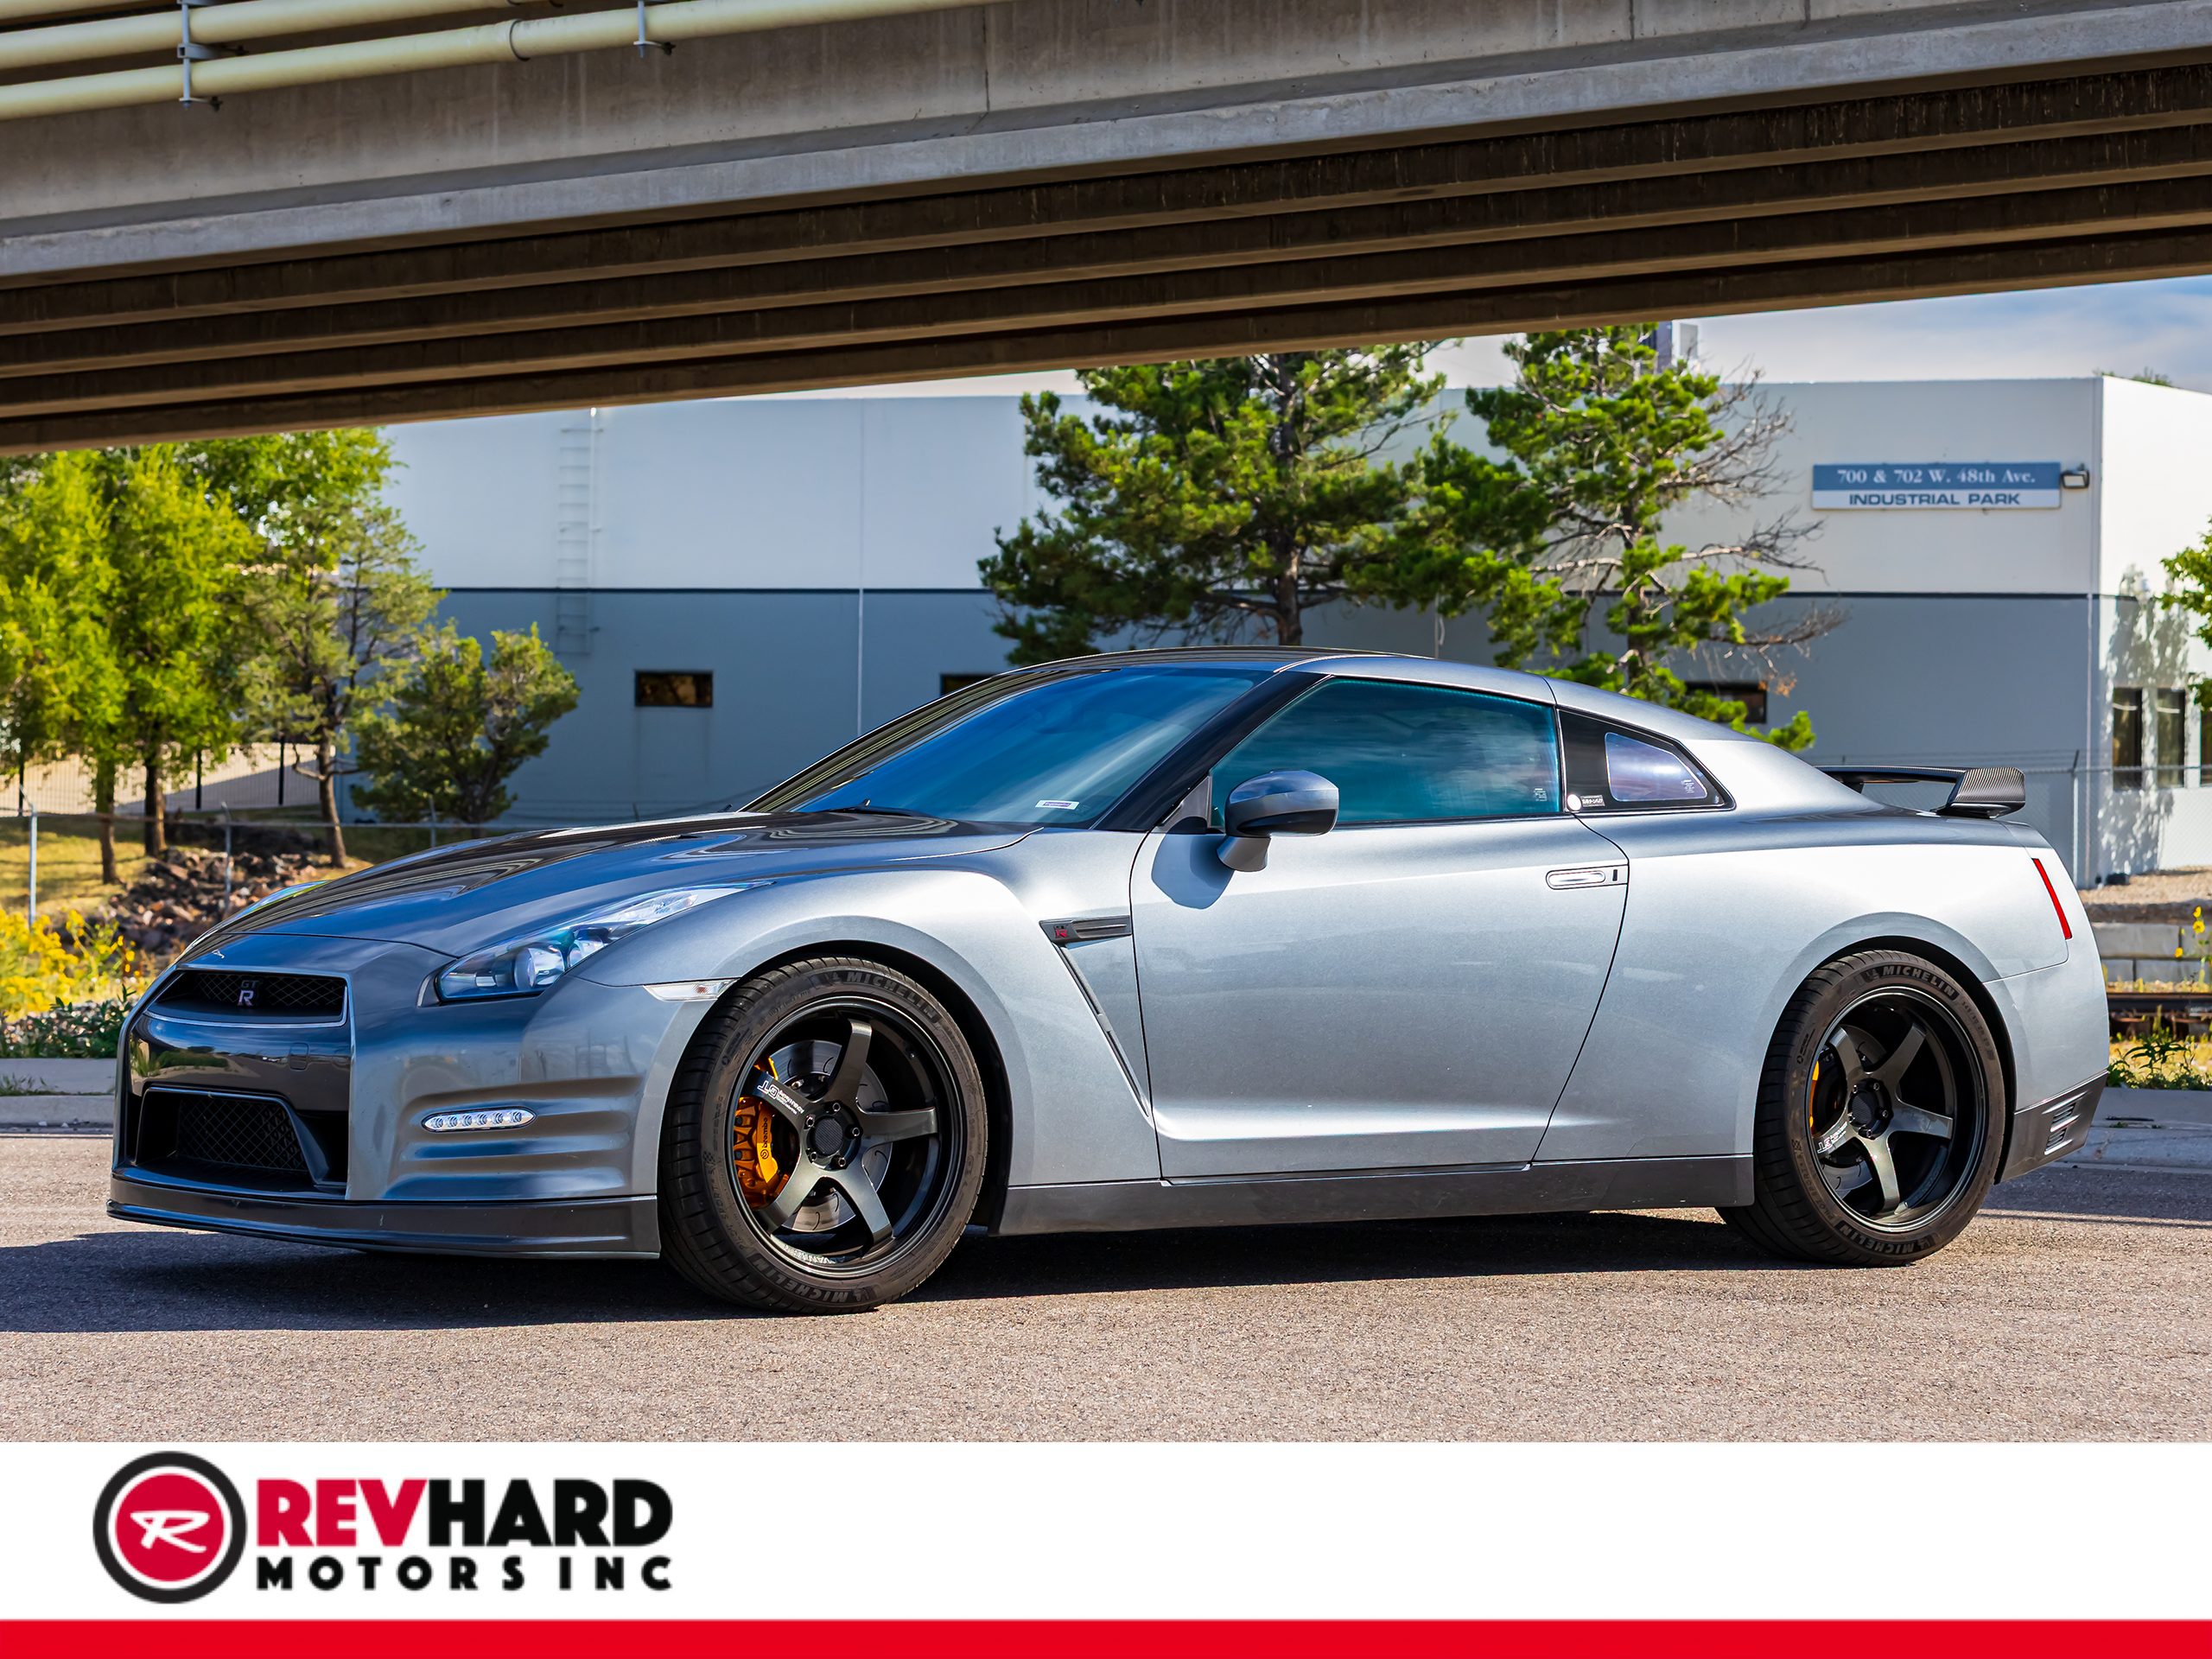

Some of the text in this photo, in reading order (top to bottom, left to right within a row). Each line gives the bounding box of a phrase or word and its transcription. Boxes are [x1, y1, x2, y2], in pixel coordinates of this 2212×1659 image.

[1837, 467, 2036, 483] 700 & 702 W. 48th Ave.
[1849, 493, 2020, 505] INDUSTRIAL PARK
[241, 980, 262, 988] GT
[1883, 965, 1956, 998] MICHELIN
[238, 990, 254, 1007] R
[846, 970, 938, 1020] MICHELIN
[757, 1080, 779, 1100] GT
[1840, 1224, 1914, 1255] MICHELIN
[753, 1258, 849, 1303] MICHELIN
